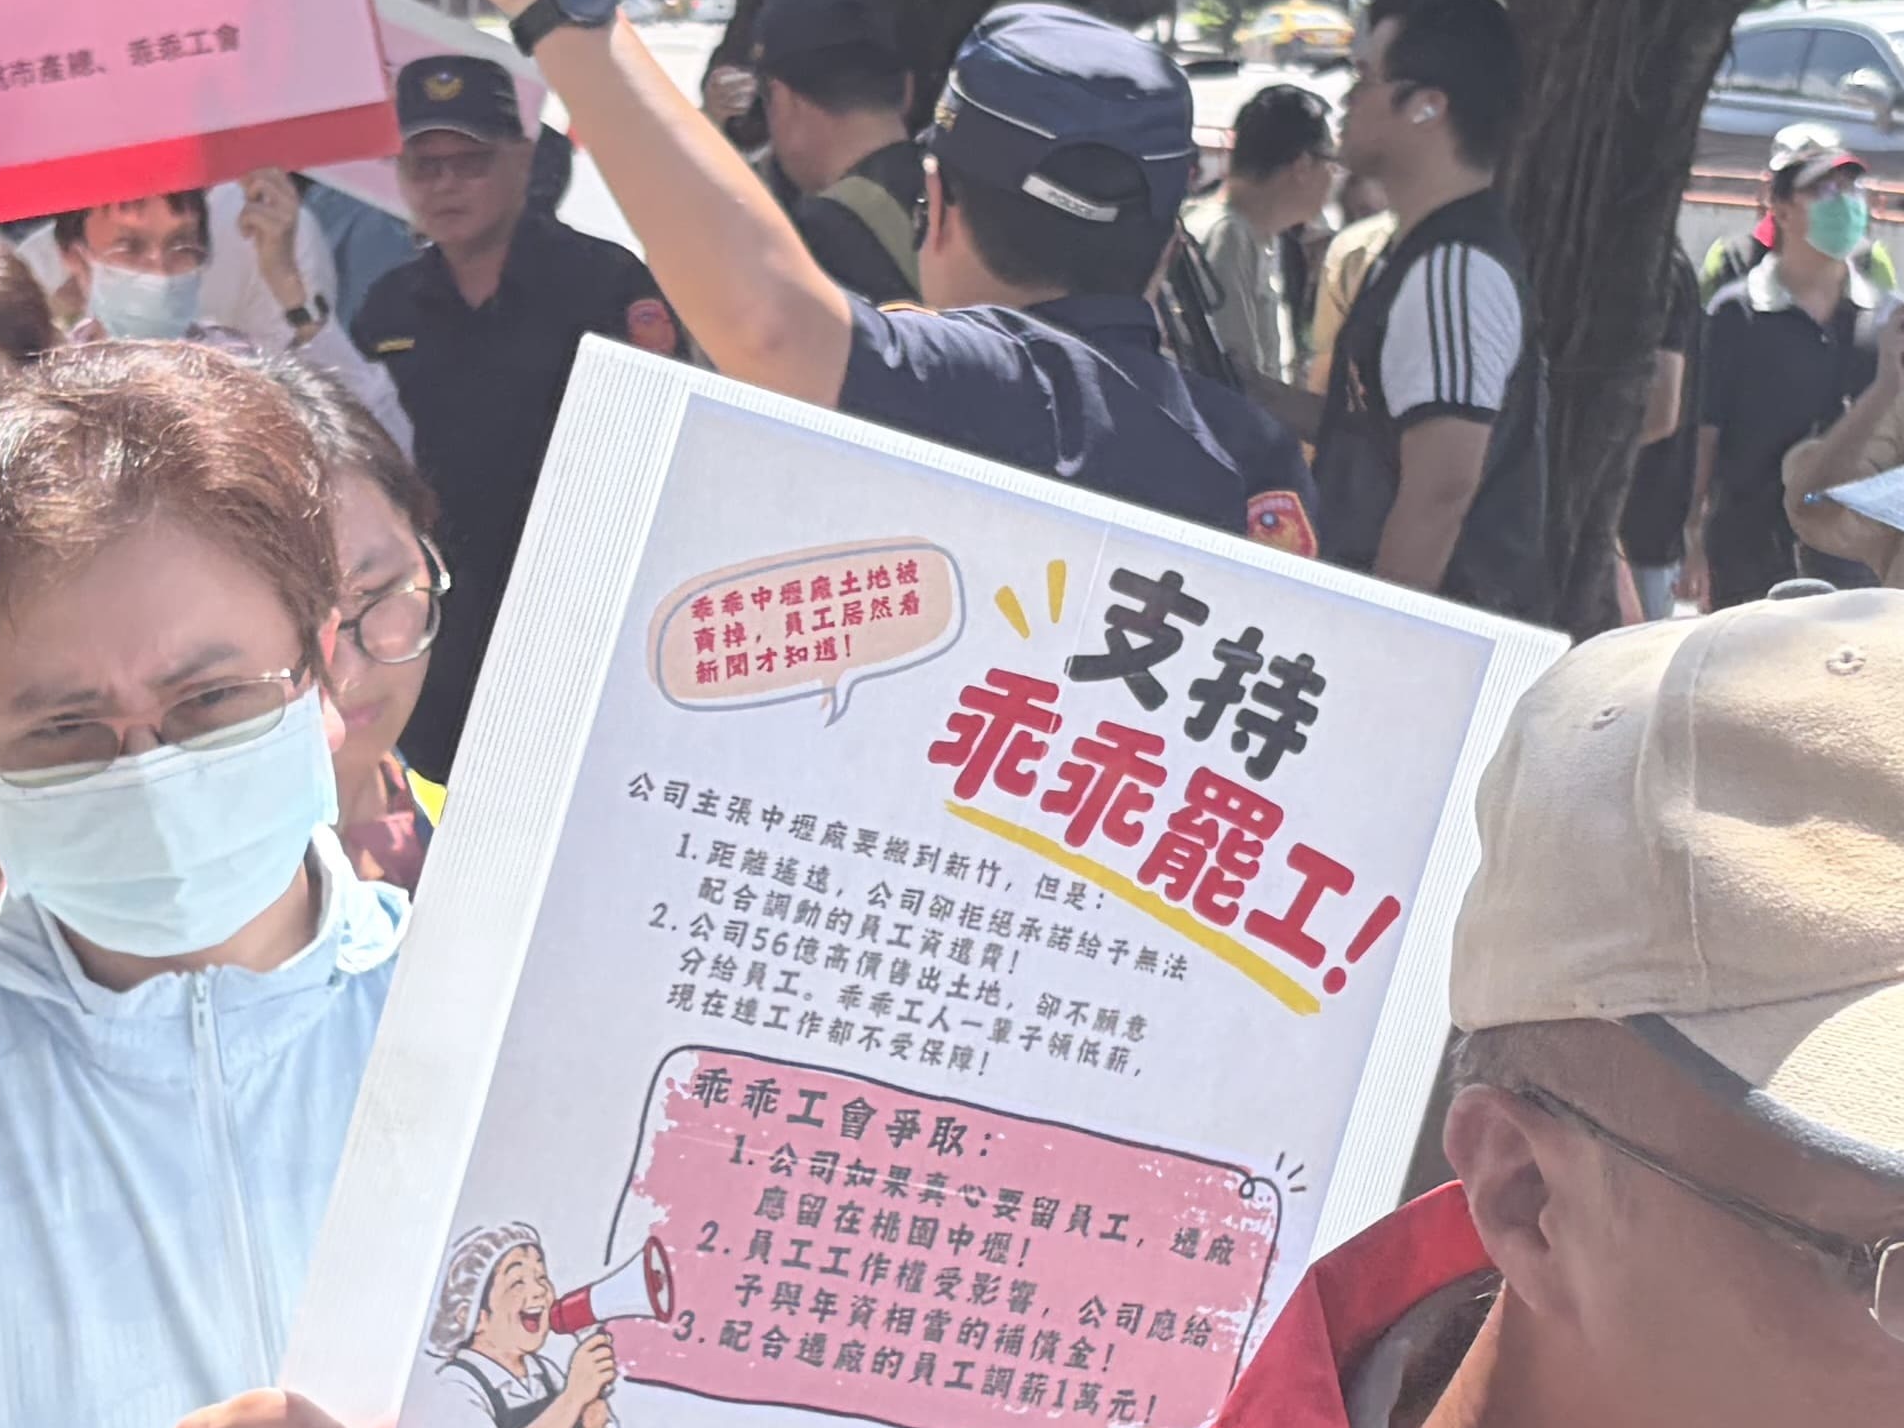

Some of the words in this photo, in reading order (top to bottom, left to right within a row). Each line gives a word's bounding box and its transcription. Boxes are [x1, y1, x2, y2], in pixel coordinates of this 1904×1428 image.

[689, 559, 920, 622] 乖乖中壢廠土地被
[1067, 568, 1327, 781] 支持
[928, 667, 1403, 995] 乖乖罷工！
[691, 1067, 993, 1158] 乖乖工會爭取：
